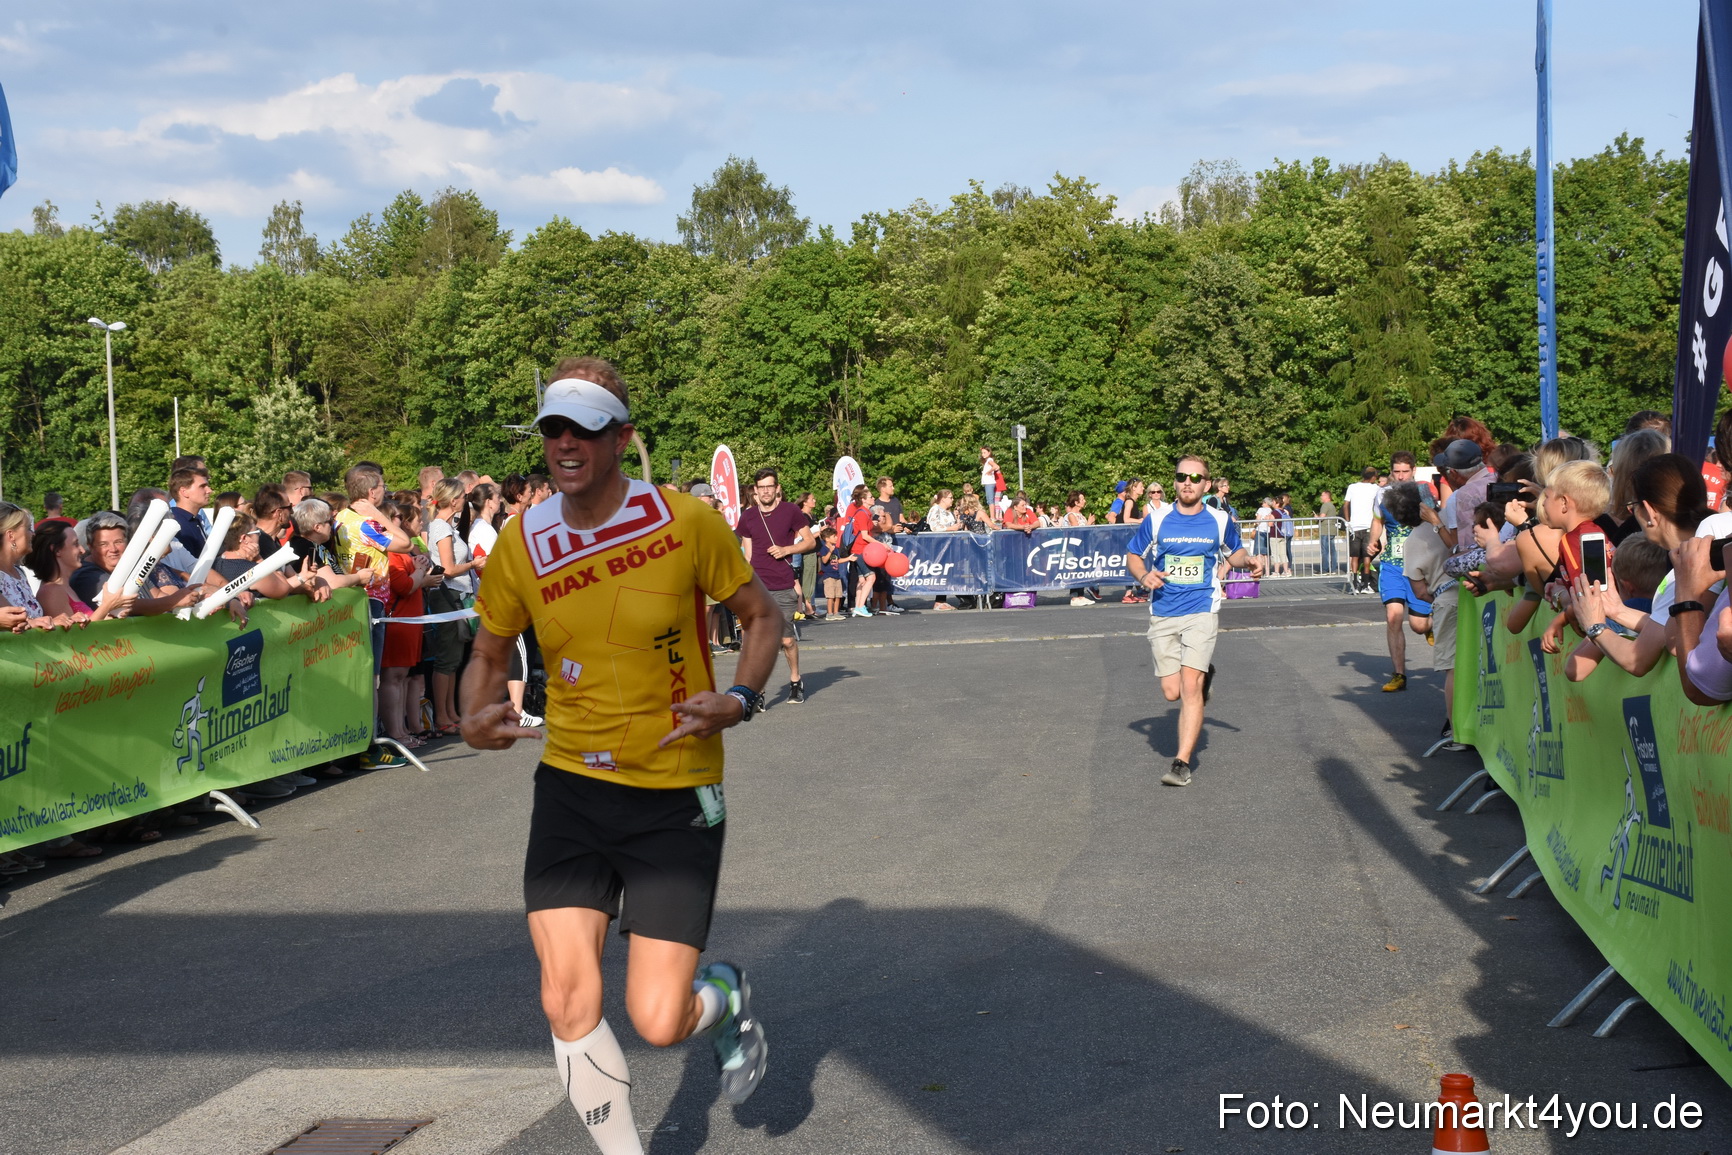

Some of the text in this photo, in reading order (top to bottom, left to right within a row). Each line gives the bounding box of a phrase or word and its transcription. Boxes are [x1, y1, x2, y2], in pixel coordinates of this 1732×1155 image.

[1162, 536, 1214, 544] energiegeladen
[540, 533, 683, 605] MAX BÖGL
[892, 578, 947, 586] TOMOBILE
[904, 558, 955, 577] cher
[1054, 569, 1126, 580] AUTOMOBILE
[1169, 565, 1199, 577] 2153
[33, 638, 137, 689] Gesunde Firmen
[55, 678, 104, 715] laufen
[207, 673, 292, 748] firmenlauf
[209, 734, 248, 764] neumarkt
[1631, 810, 1694, 902] firmenlauf
[1624, 889, 1660, 920] neumarkt
